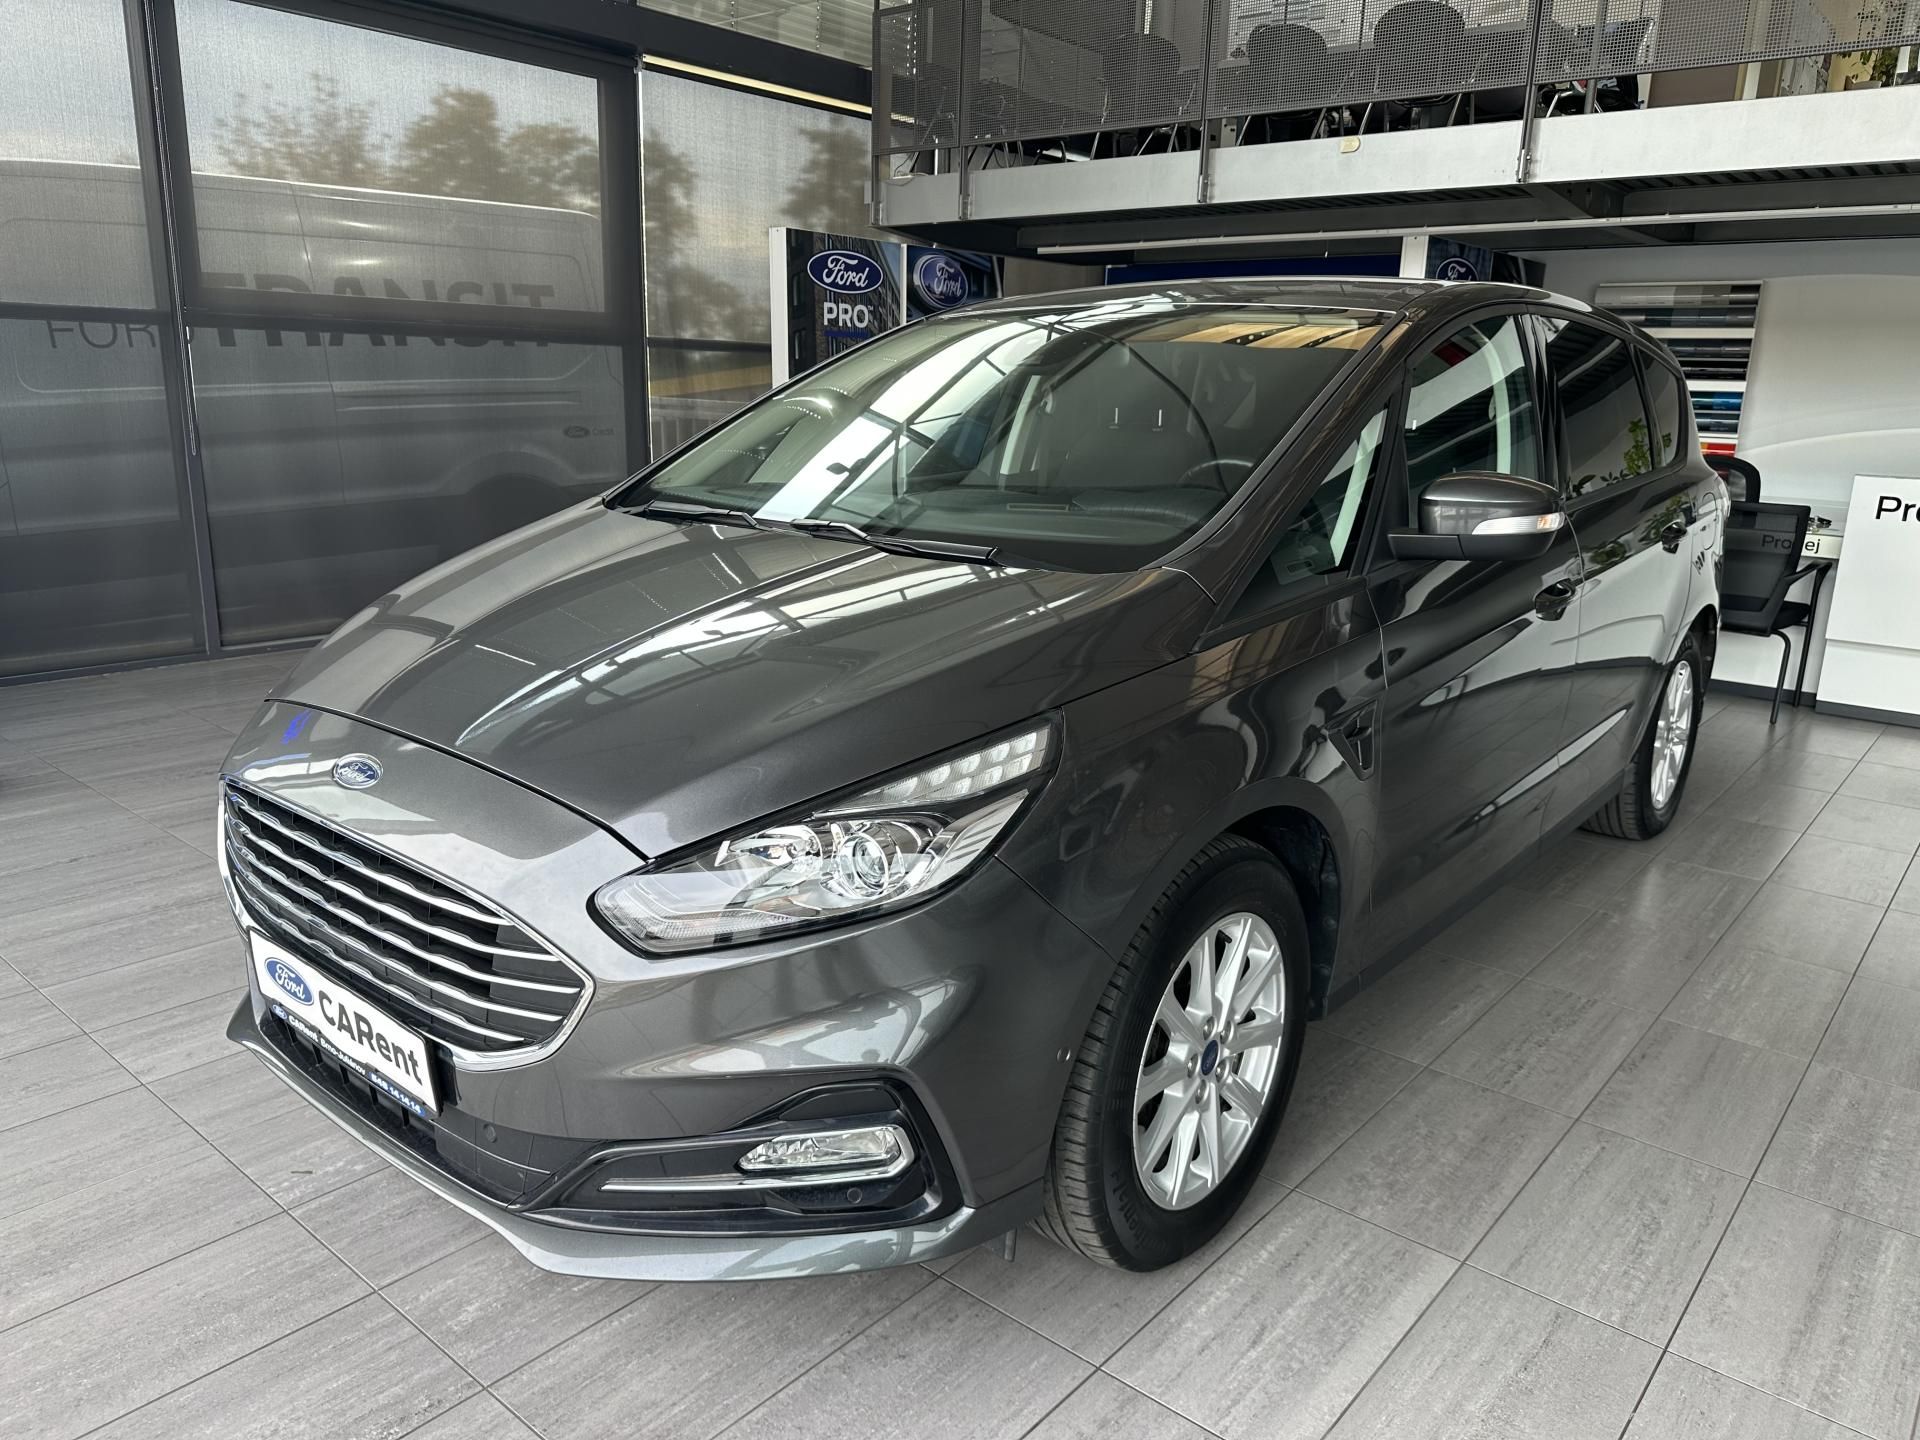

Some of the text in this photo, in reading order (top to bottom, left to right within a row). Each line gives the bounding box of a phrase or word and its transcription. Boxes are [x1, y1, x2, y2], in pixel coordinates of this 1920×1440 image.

[823, 255, 869, 288] Ford
[933, 262, 962, 297] Ford
[1875, 496, 1920, 522] Pr
[1761, 534, 1821, 554] Proej
[274, 962, 423, 1086] Ford CARent
